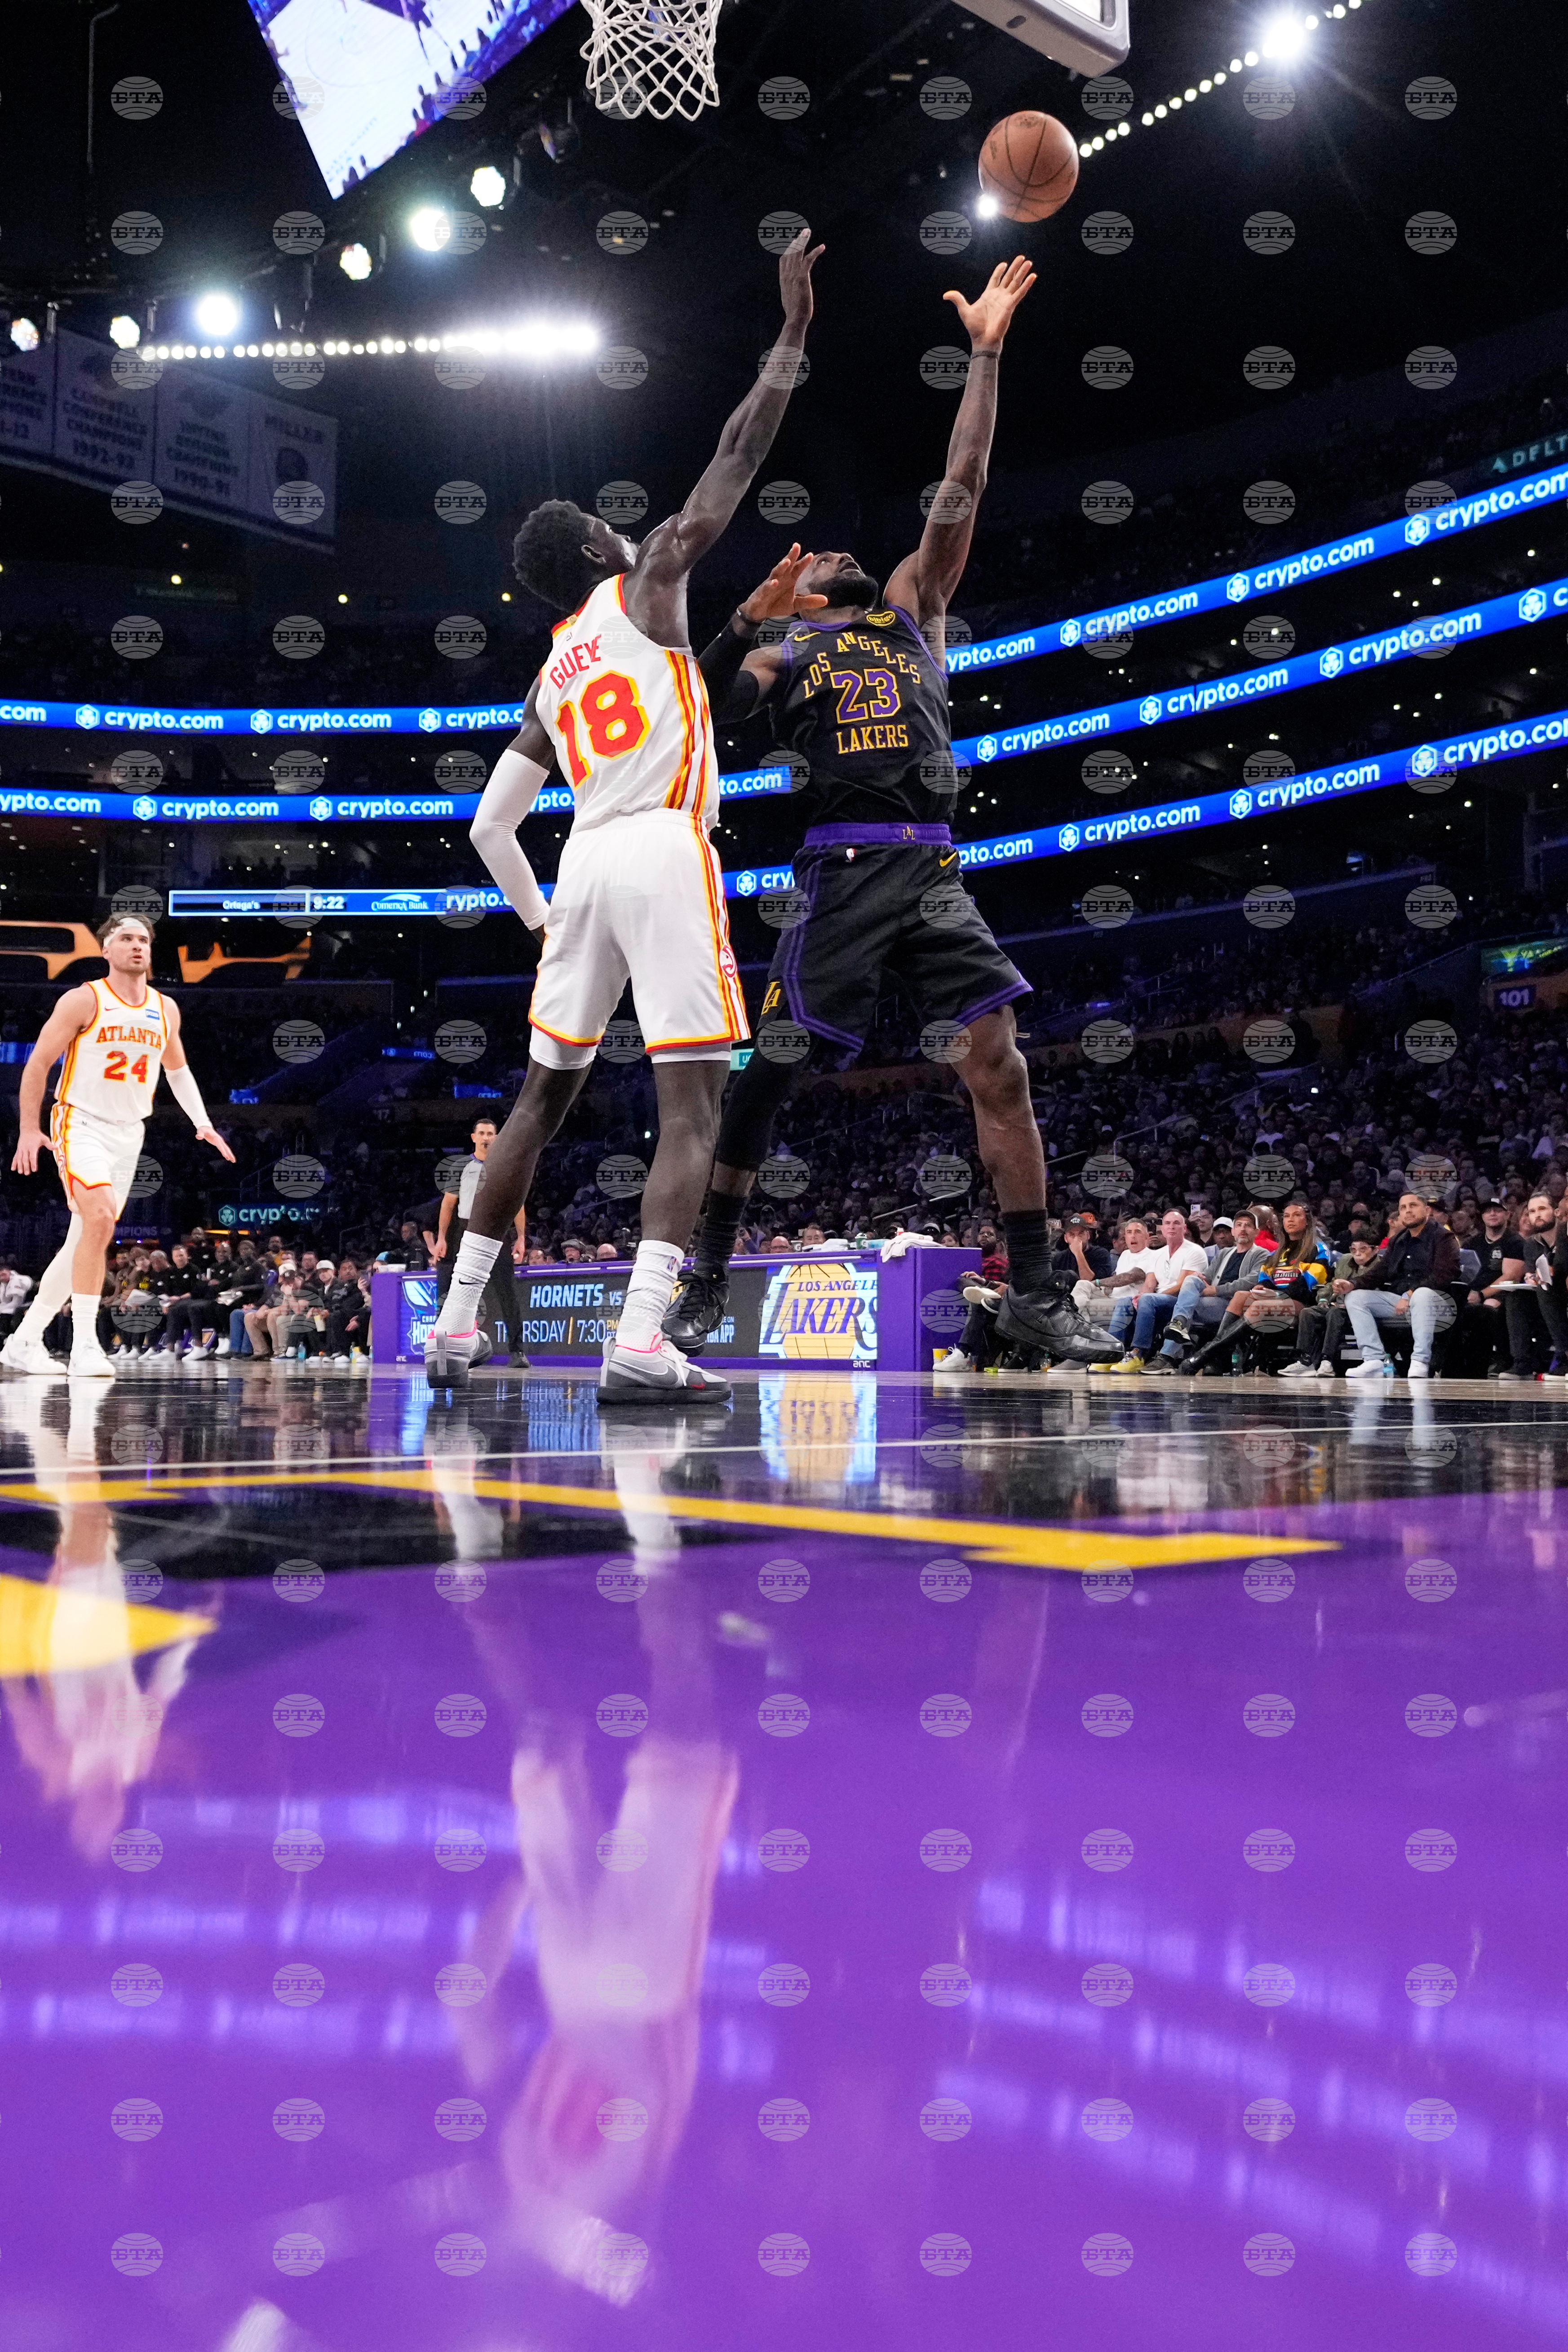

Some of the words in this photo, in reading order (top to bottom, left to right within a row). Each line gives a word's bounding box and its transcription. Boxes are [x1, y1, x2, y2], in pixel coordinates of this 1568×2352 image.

[1254, 537, 1374, 589] crypto.com
[868, 614, 893, 623] bibigo
[1085, 592, 1198, 633] crypto.com
[1349, 612, 1482, 664] crypto.com
[549, 634, 602, 689] GUEYE
[803, 652, 831, 698] LOS
[837, 631, 921, 684] ANGELES
[829, 667, 901, 724] 23
[1167, 669, 1288, 713] crypto.com
[104, 711, 224, 731] crypto.com
[277, 711, 392, 731] crypto.com
[554, 669, 651, 791] 18
[1002, 713, 1110, 751] crypto.com
[836, 724, 909, 754] LAKERS
[1258, 763, 1380, 807] crypto.com
[162, 799, 279, 820] crypto.com
[337, 798, 453, 819] crypto.com
[1085, 805, 1200, 842] crypto.com
[222, 899, 261, 912] Ortega's
[313, 895, 344, 910] 9:22
[408, 900, 429, 910] Bank
[1499, 988, 1529, 1007] 101
[96, 1026, 161, 1050] ATLANTA
[104, 1050, 149, 1083] 24
[529, 1283, 604, 1308] HORNETS
[609, 1291, 622, 1306] VS
[797, 1281, 821, 1292] LOS
[577, 1319, 606, 1343] 7:30
[720, 1324, 735, 1343] APP
[852, 1360, 871, 1368] anc
